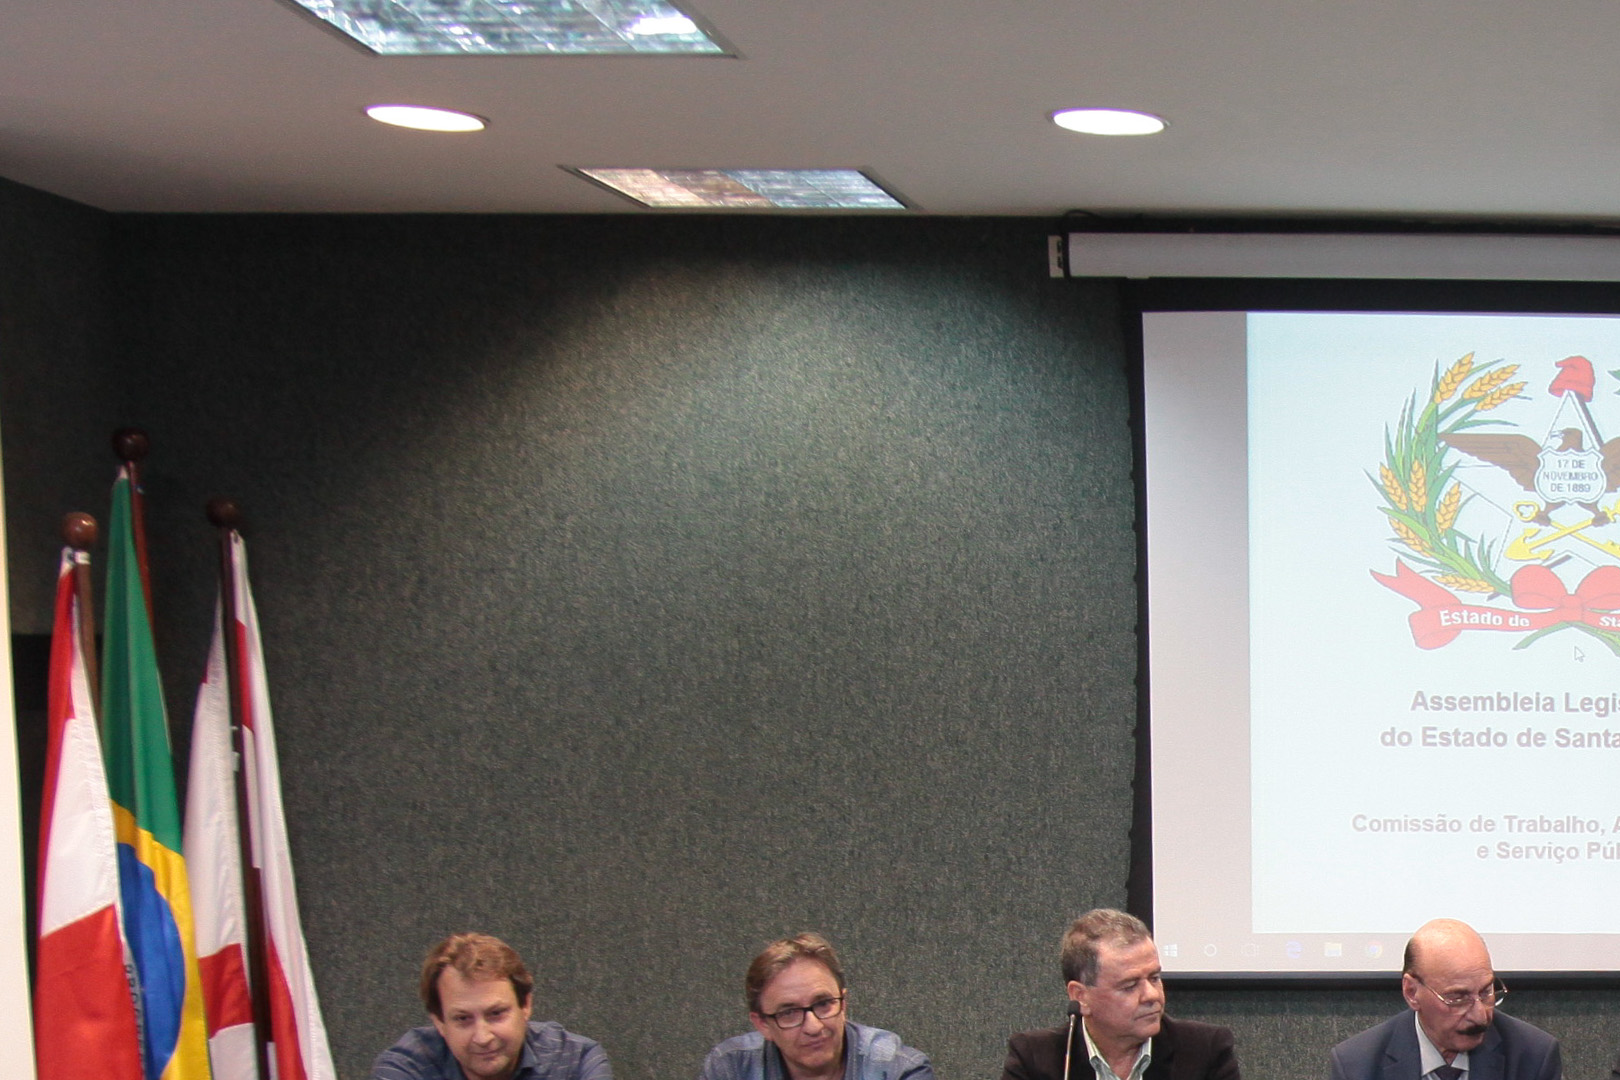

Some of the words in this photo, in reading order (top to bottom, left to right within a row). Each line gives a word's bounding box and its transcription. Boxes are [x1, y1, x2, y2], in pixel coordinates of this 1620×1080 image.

[1557, 459, 1569, 468] 17
[1571, 459, 1586, 469] DE
[1542, 471, 1599, 481] NOVEMBRO
[1550, 483, 1563, 492] DE
[1567, 483, 1591, 493] 1889
[1439, 609, 1503, 627] Estado
[1508, 614, 1530, 627] de
[1410, 690, 1556, 713] Assembleia
[1380, 726, 1413, 748] do
[1421, 726, 1508, 748] Estado
[1516, 727, 1547, 749] de
[1351, 814, 1463, 834] Comissão
[1469, 815, 1496, 834] de
[1503, 815, 1606, 837] Trabalho,
[1476, 845, 1490, 860] e
[1496, 842, 1580, 864] Serviço
